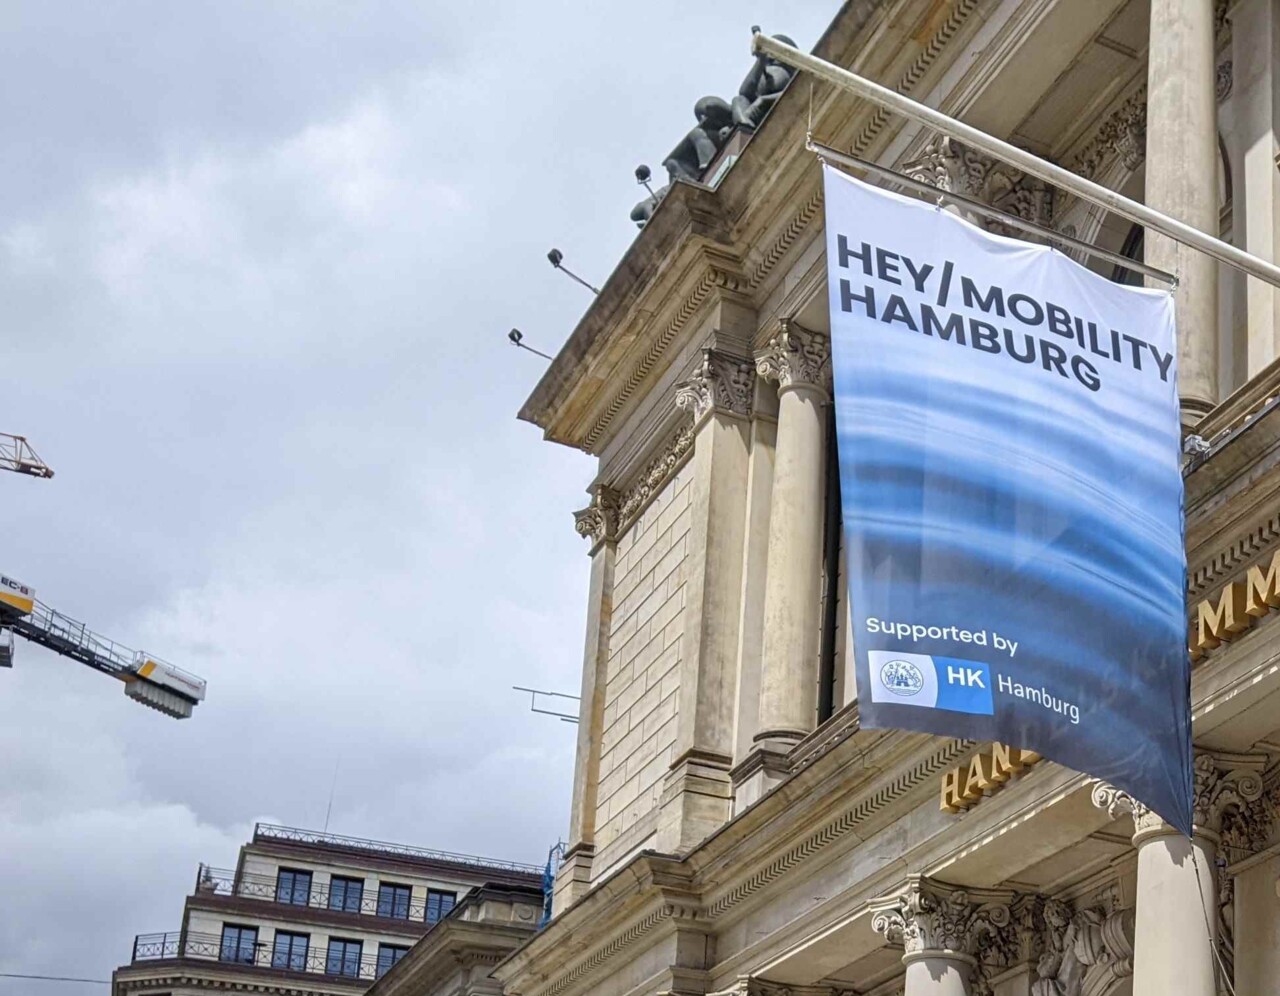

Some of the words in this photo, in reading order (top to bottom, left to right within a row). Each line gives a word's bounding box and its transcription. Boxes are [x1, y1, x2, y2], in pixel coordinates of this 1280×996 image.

[837, 233, 1174, 383] HEY/MOBILITY
[839, 278, 1101, 392] HAMBURG
[866, 617, 987, 646] Supported
[993, 632, 1018, 657] by
[947, 665, 986, 689] HK
[998, 673, 1080, 725] Hamburg
